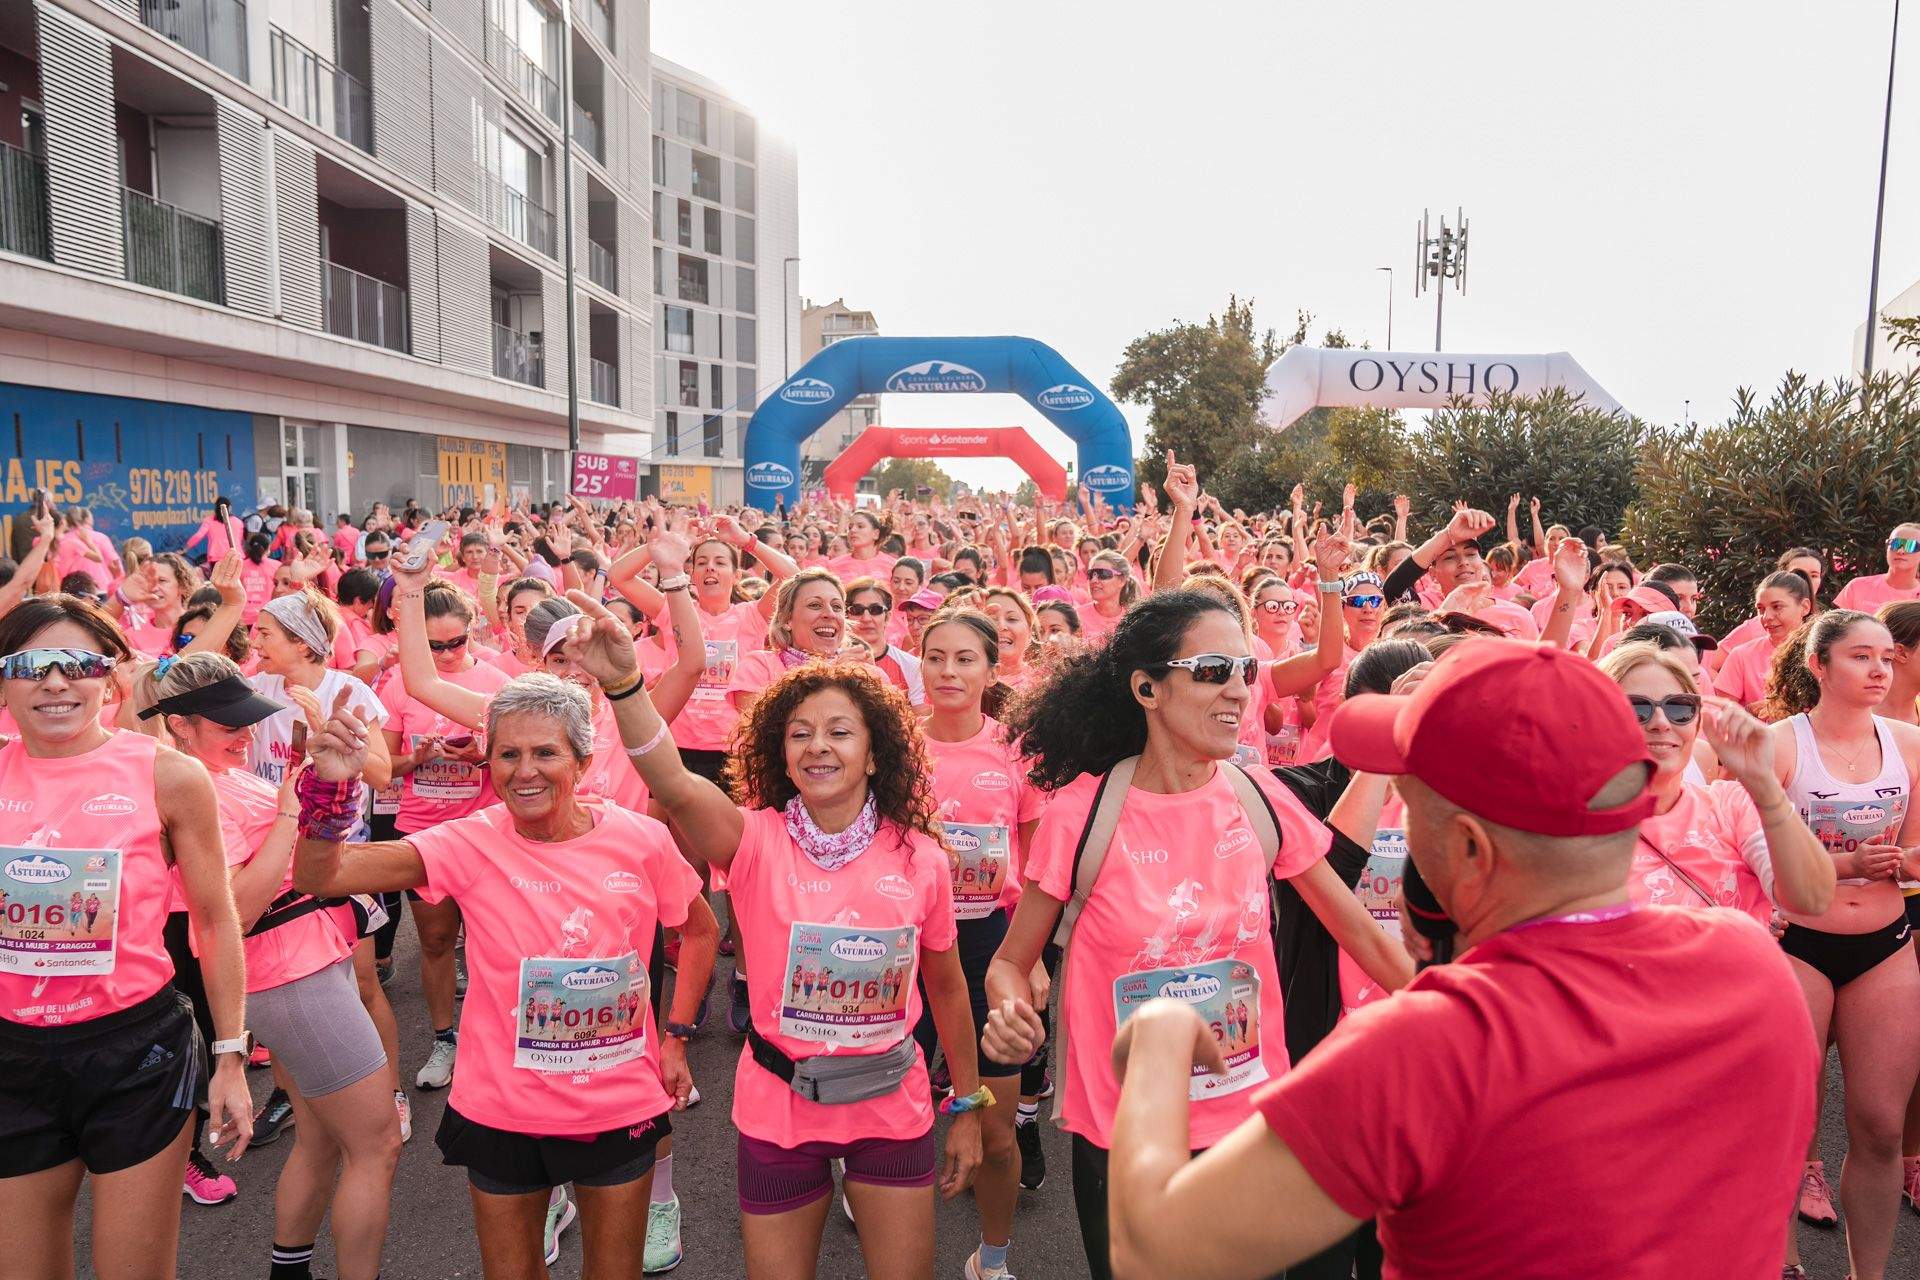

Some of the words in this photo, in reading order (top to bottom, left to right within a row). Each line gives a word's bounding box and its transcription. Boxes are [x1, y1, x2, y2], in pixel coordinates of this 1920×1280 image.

[1350, 358, 1519, 394] OYSHO
[896, 378, 979, 392] ASTURIANA
[784, 387, 831, 399] ASTURIANA
[1042, 394, 1091, 405] ASTURIANA
[899, 434, 928, 446] Sports
[940, 434, 988, 445] Santander
[577, 455, 609, 471] SUB
[0, 458, 83, 504] AJES
[749, 472, 791, 483] ASTURIANA
[129, 467, 162, 505] 976
[164, 469, 192, 505] 219
[194, 470, 219, 504] 115
[431, 763, 459, 774] 016
[9, 864, 67, 878] ASTURIANA
[510, 875, 561, 893] OYSHO
[787, 872, 832, 895] OSHO
[7, 902, 65, 926] 016
[962, 905, 991, 914] Santander
[18, 929, 45, 940] 1024
[25, 942, 50, 951] MUJER
[56, 942, 97, 951] ZARAGOZA
[833, 943, 884, 956] ASTURIANA
[46, 958, 97, 968] Santander
[529, 970, 553, 978] SUMA
[565, 975, 616, 987] ASTURIANA
[829, 979, 879, 999] 016
[1122, 983, 1148, 993] SUMA
[1164, 983, 1219, 998] ASTURIANA
[46, 1004, 57, 1014] DE
[66, 997, 94, 1013] MUJER
[841, 1005, 860, 1014] 934
[43, 1014, 62, 1024] 2024
[563, 1006, 614, 1028] 016
[796, 1010, 824, 1021] CARRERA
[826, 1012, 835, 1021] DE
[836, 1013, 844, 1022] LA
[845, 1014, 865, 1023] MUJER
[870, 1012, 897, 1022] ZARAGOZA
[574, 1029, 597, 1040] 6092
[794, 1023, 837, 1037] OYSHO
[531, 1041, 560, 1049] CARRERA
[561, 1040, 570, 1049] DE
[571, 1040, 579, 1048] LA
[580, 1038, 601, 1047] MUJER
[605, 1032, 634, 1044] ZARAGOZA
[531, 1053, 573, 1064] OYSHO
[598, 1047, 634, 1060] Santander
[1223, 1050, 1251, 1065] ARAGOZA
[572, 1074, 590, 1085] 2024
[1216, 1069, 1251, 1087] Santander
